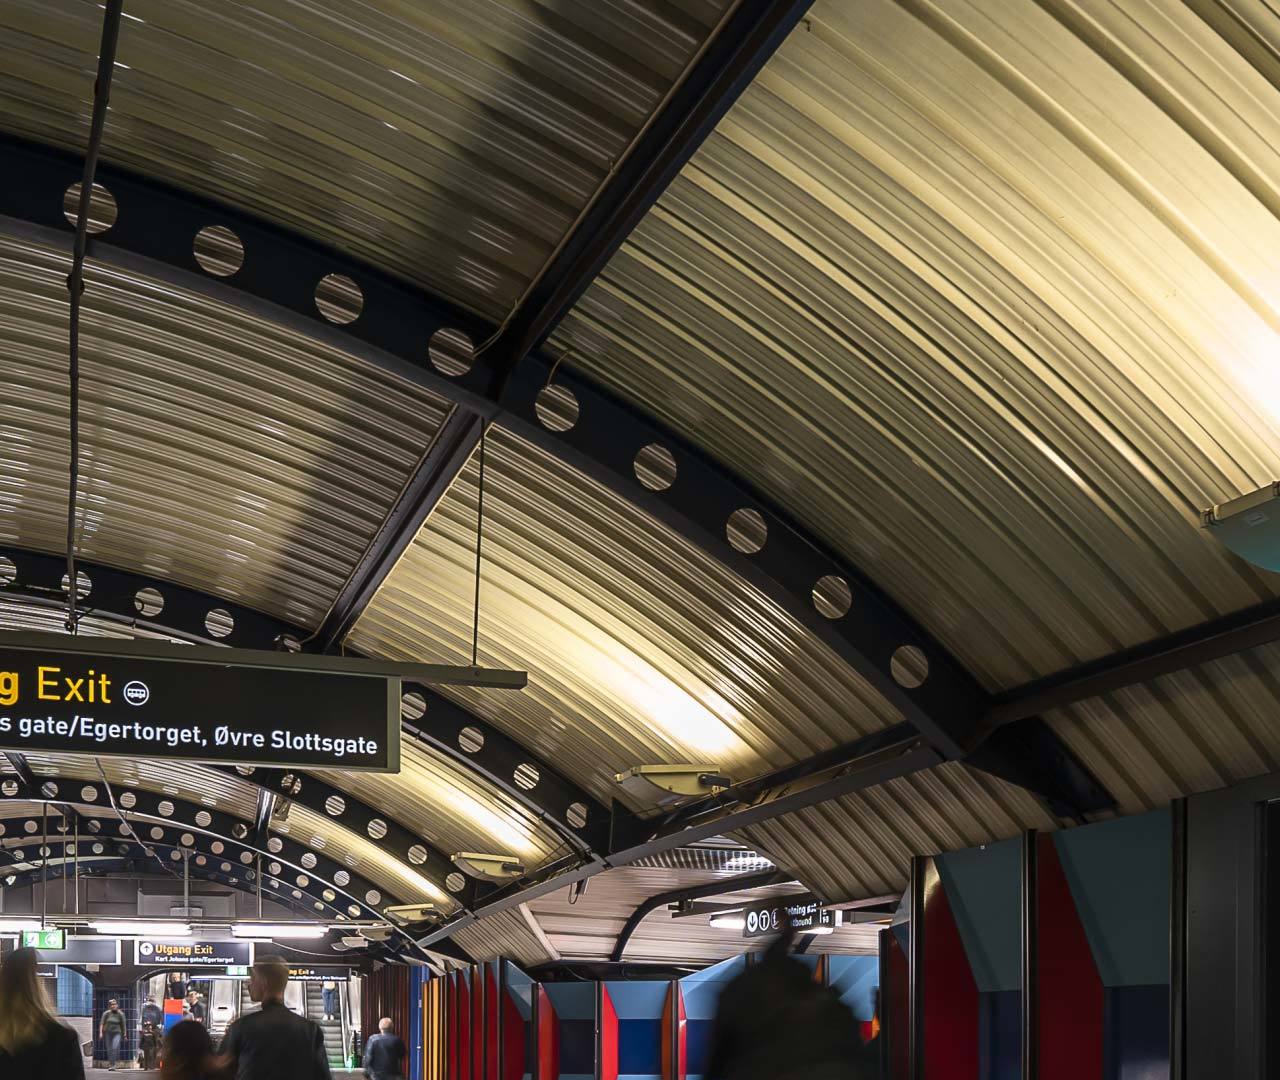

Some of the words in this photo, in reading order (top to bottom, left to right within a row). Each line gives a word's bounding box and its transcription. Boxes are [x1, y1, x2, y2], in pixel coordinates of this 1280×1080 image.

[37, 666, 112, 704] Exit
[18, 716, 208, 747] gate/Egertorget,
[214, 726, 265, 748] Øvre
[271, 730, 378, 756] Slottsgate
[155, 944, 191, 955] Utgang
[194, 945, 213, 954] Exit
